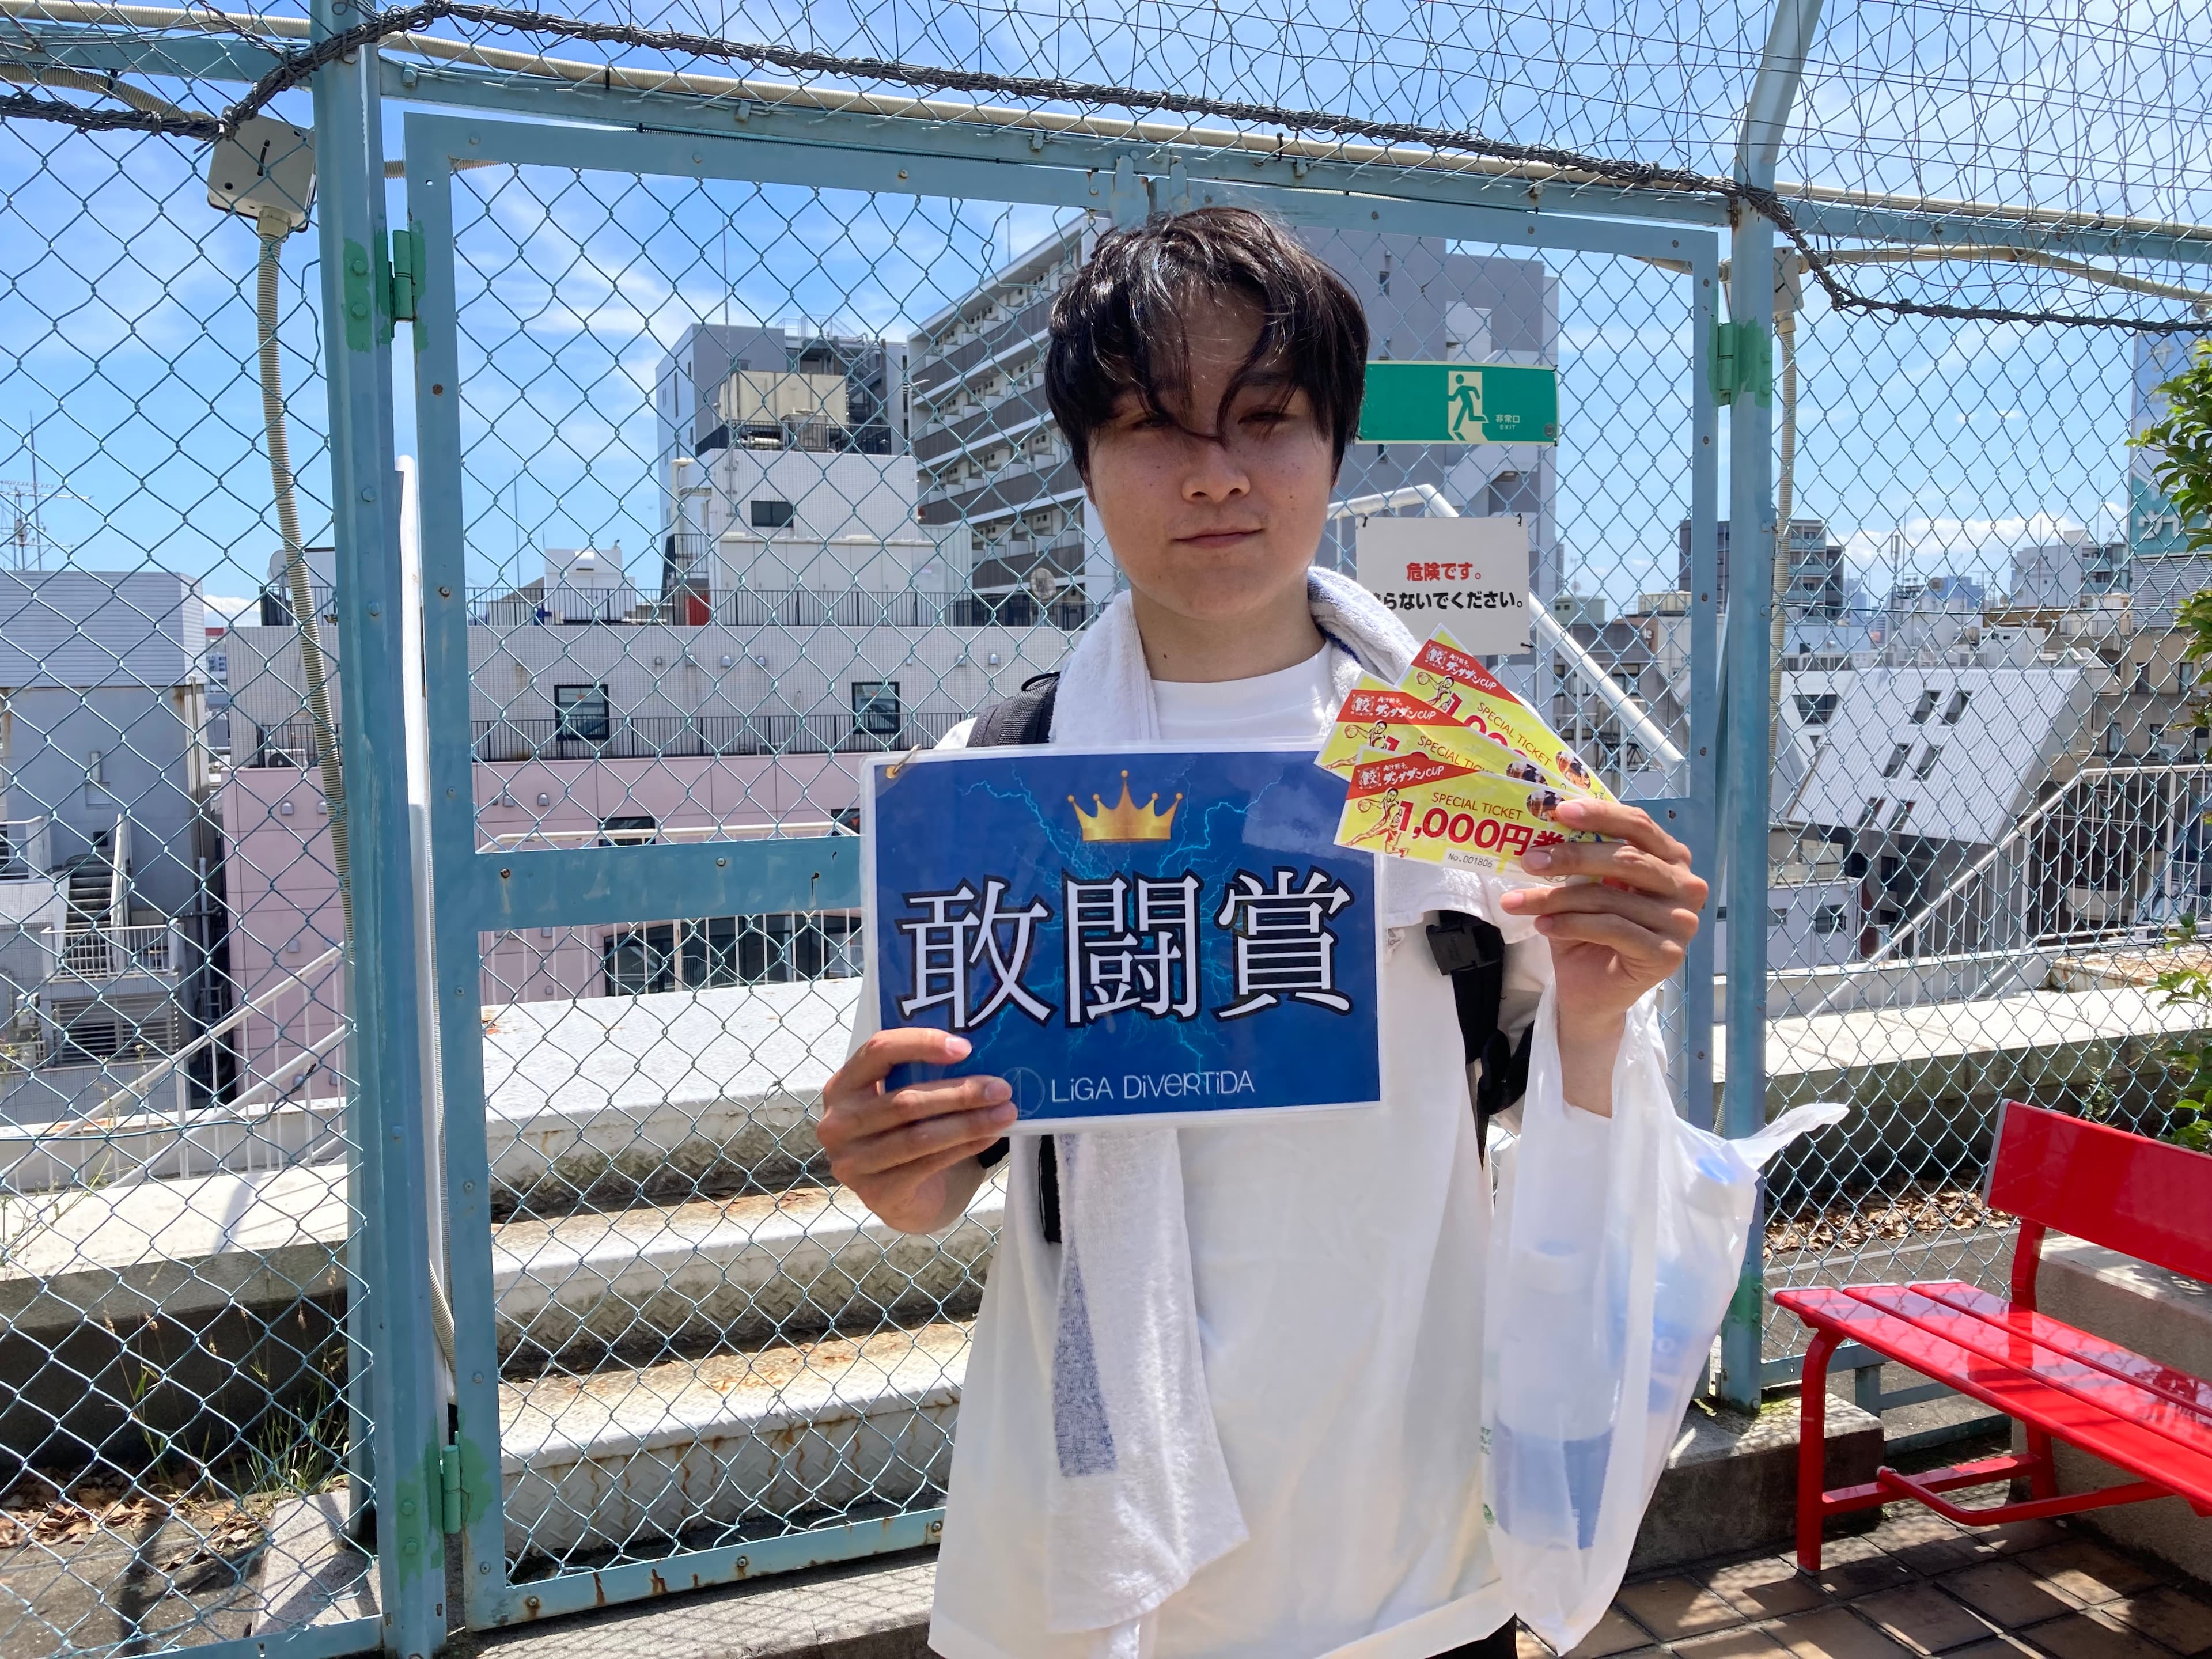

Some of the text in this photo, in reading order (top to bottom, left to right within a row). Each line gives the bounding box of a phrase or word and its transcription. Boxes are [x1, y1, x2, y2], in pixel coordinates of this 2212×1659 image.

[1495, 414, 1521, 423] 非常口
[1406, 562, 1482, 582] 危険です。
[1373, 591, 1523, 611] らないでください。
[1477, 702, 1514, 738] SPECIAL
[1517, 733, 1552, 766] TICKET
[1417, 736, 1460, 765] SPECIAL
[1431, 792, 1523, 821] SPECIAL TICKET
[897, 868, 1354, 1033] 敢闘賞
